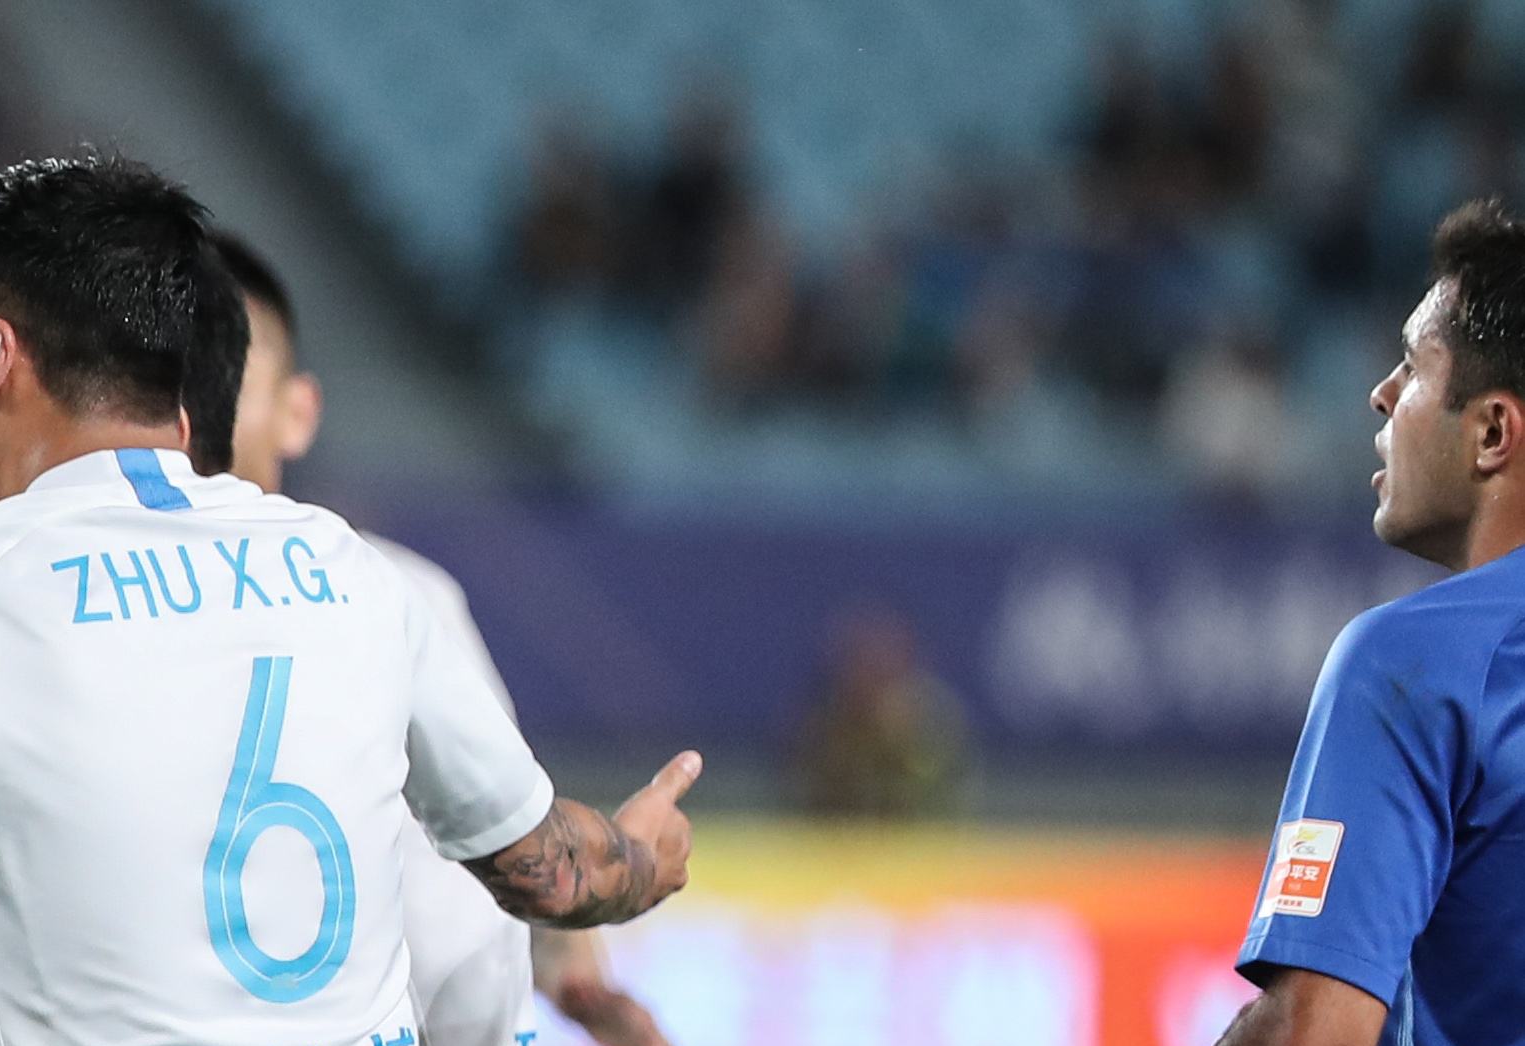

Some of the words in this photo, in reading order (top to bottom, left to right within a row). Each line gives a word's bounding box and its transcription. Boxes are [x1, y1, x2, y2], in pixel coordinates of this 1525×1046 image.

[50, 544, 202, 624] ZHU
[212, 536, 349, 610] X.G.
[202, 655, 356, 1004] 6
